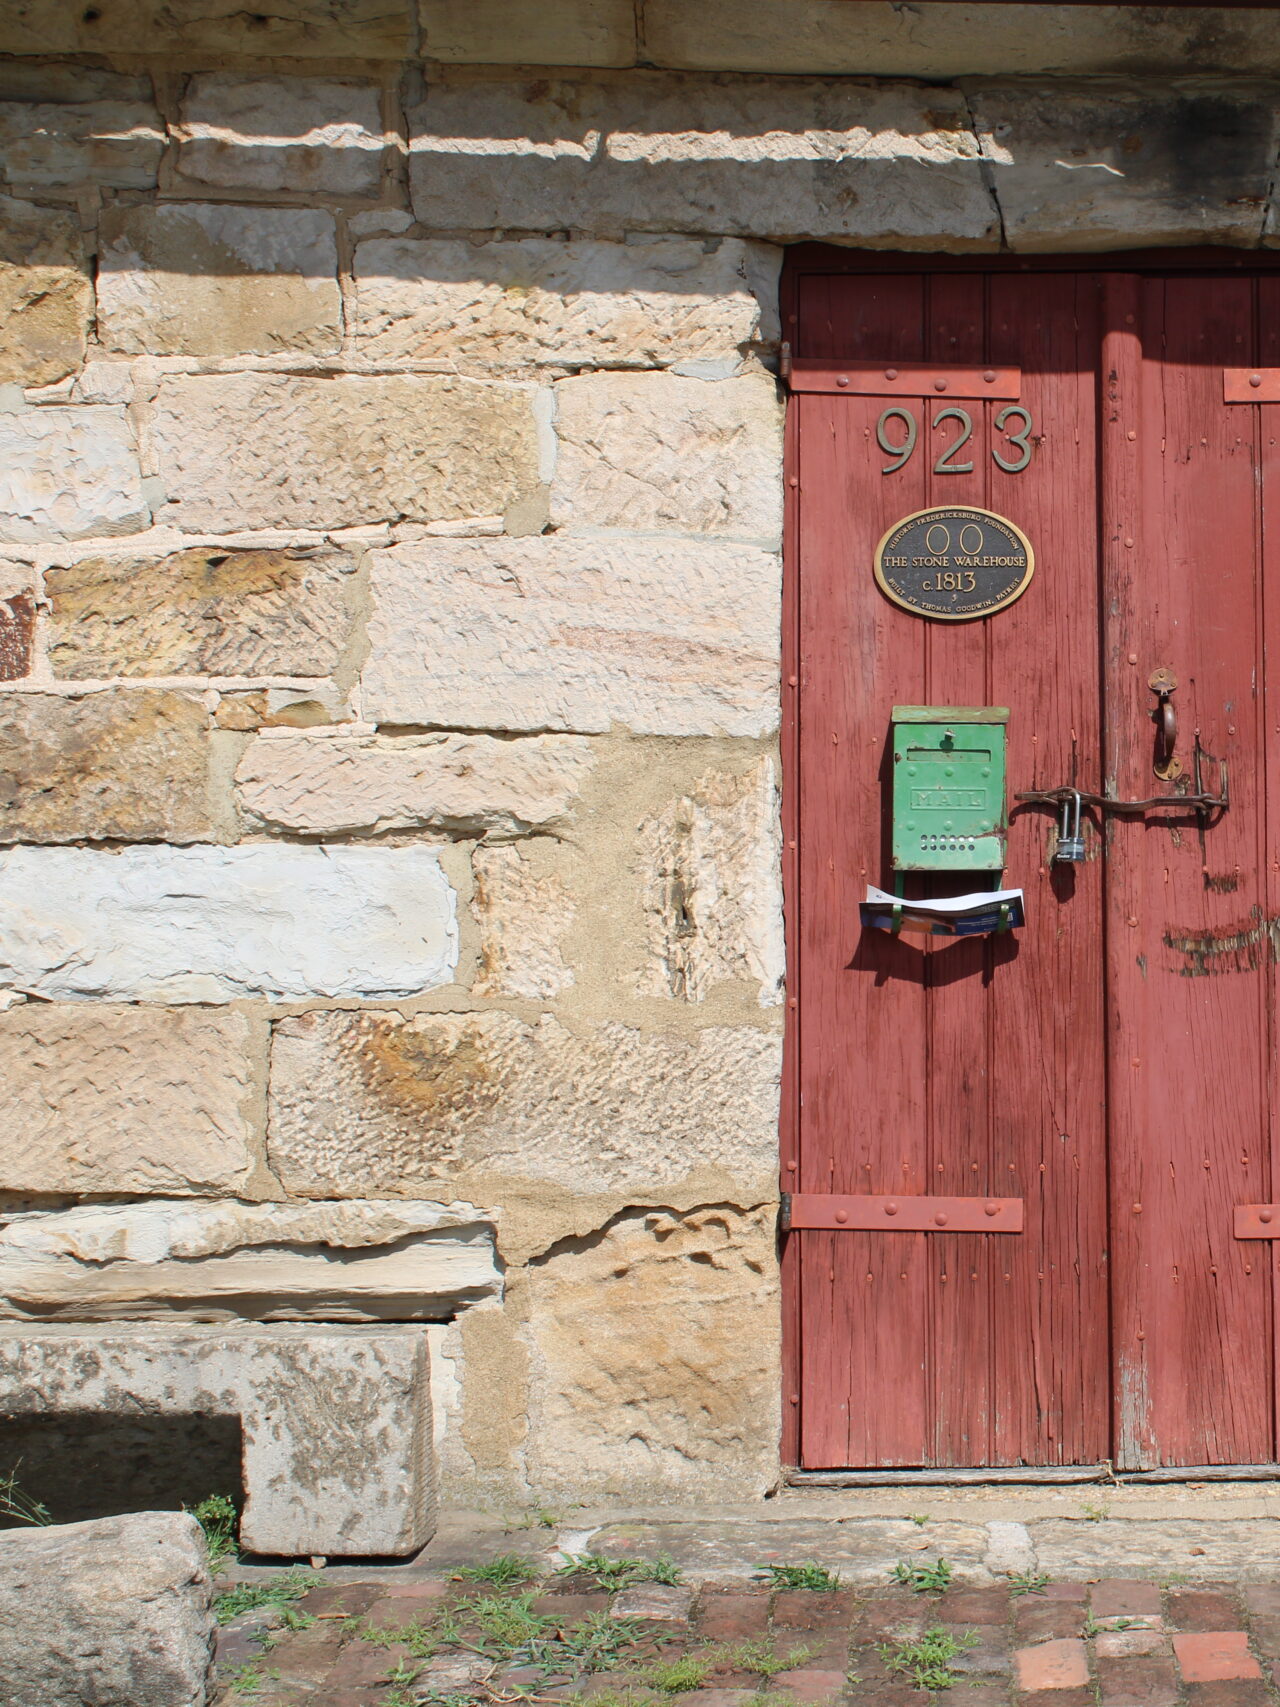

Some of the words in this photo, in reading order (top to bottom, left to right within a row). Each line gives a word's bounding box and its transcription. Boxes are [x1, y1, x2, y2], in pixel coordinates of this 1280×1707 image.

[876, 406, 1032, 473] 923
[889, 523, 915, 550] HISTORIC
[916, 512, 981, 526] FREDERICKSBURG
[984, 518, 1019, 550] FOUNDATION
[883, 556, 908, 567] THE
[912, 556, 950, 567] STONE
[954, 556, 1026, 567] WAREHOUSE
[888, 577, 906, 596] BUILT
[907, 595, 918, 604] BY
[921, 602, 951, 612] THOMAS
[995, 577, 1020, 601] PATRIOT
[914, 791, 982, 807] MAIL
